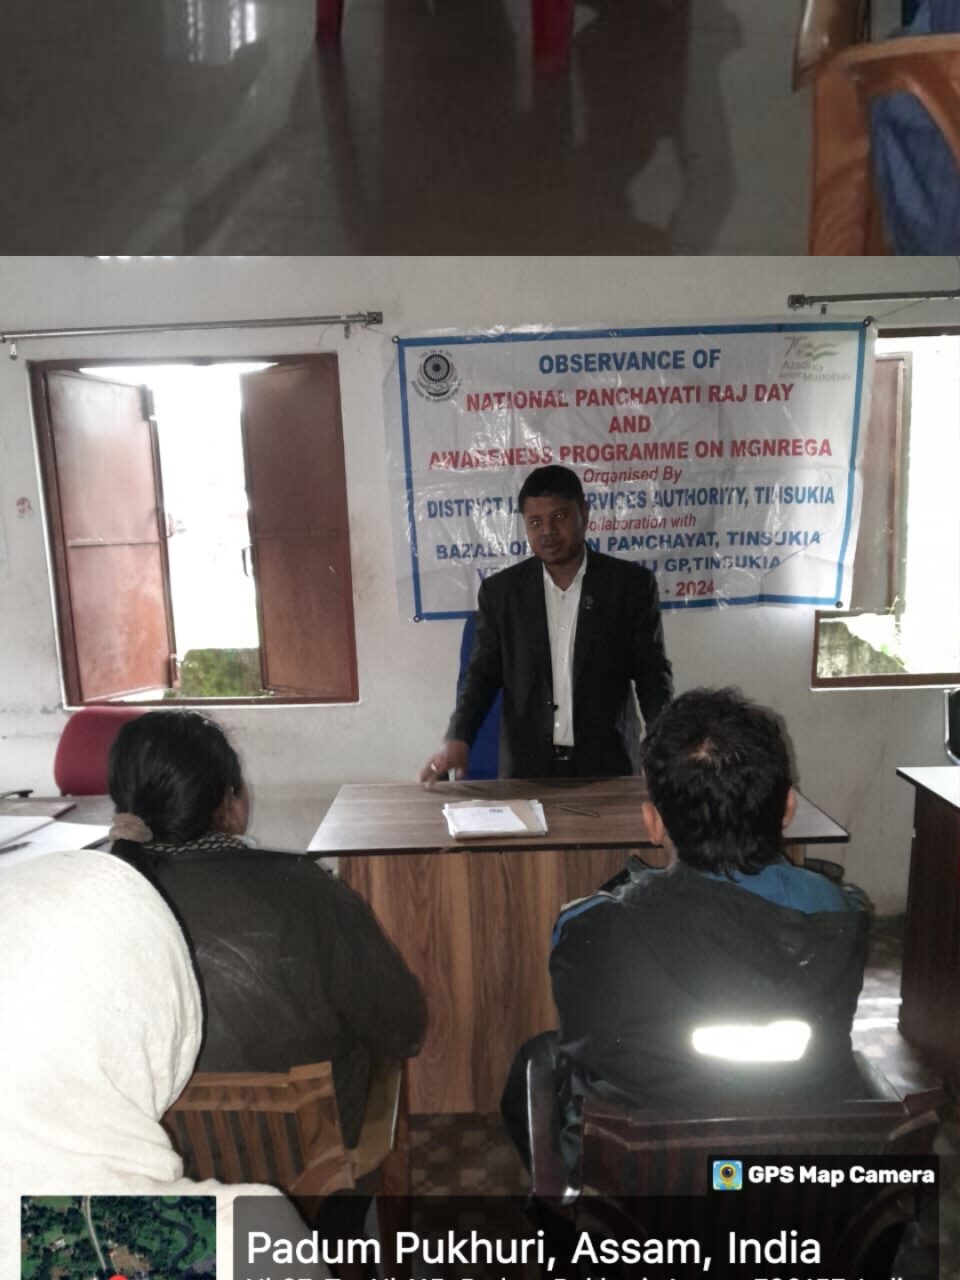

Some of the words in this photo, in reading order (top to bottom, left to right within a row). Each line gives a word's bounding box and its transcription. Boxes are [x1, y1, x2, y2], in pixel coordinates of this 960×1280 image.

[538, 350, 685, 374] OBSERVANCE
[693, 349, 721, 369] OF
[467, 389, 569, 412] NATIONAL
[575, 385, 701, 408] PANCHAYATI
[708, 384, 748, 403] RAJ
[754, 383, 794, 402] DAY
[608, 415, 651, 434] AND
[559, 441, 689, 464] PROGRAMME
[695, 440, 723, 458] ON
[731, 438, 832, 458] MGNREGA
[583, 467, 657, 486] Organised
[662, 466, 682, 485] By
[588, 490, 647, 510] RVICES
[654, 487, 749, 509] AUTHORITY,
[755, 486, 835, 505] TINSUKIA
[671, 514, 696, 529] with
[607, 532, 720, 552] PANCHAYAT,
[727, 531, 821, 547] TINSUKIA
[675, 580, 715, 597] 2024
